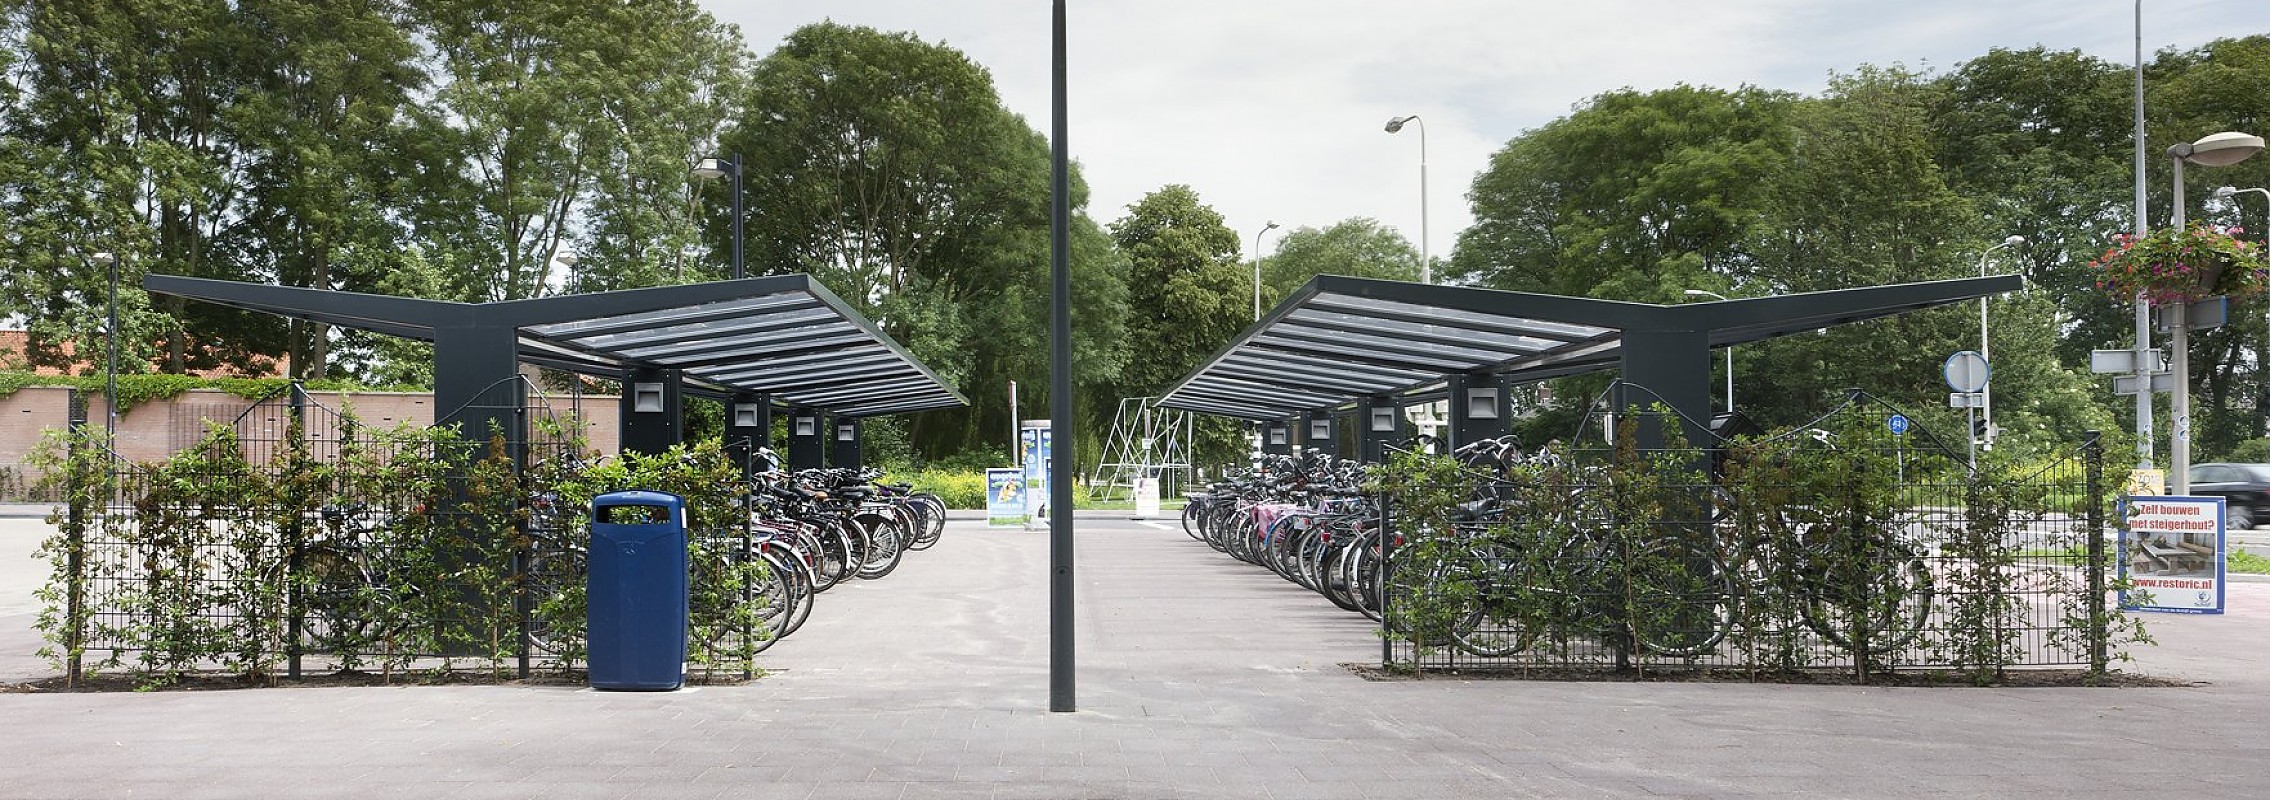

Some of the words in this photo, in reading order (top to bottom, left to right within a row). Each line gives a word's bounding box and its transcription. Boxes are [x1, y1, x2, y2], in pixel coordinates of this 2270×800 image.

[2140, 504, 2158, 515] Zelf
[2160, 504, 2200, 515] bouwen
[2129, 519, 2147, 529] met
[2149, 519, 2215, 531] steigerhout?
[2131, 579, 2213, 590] www.restoric.nl
